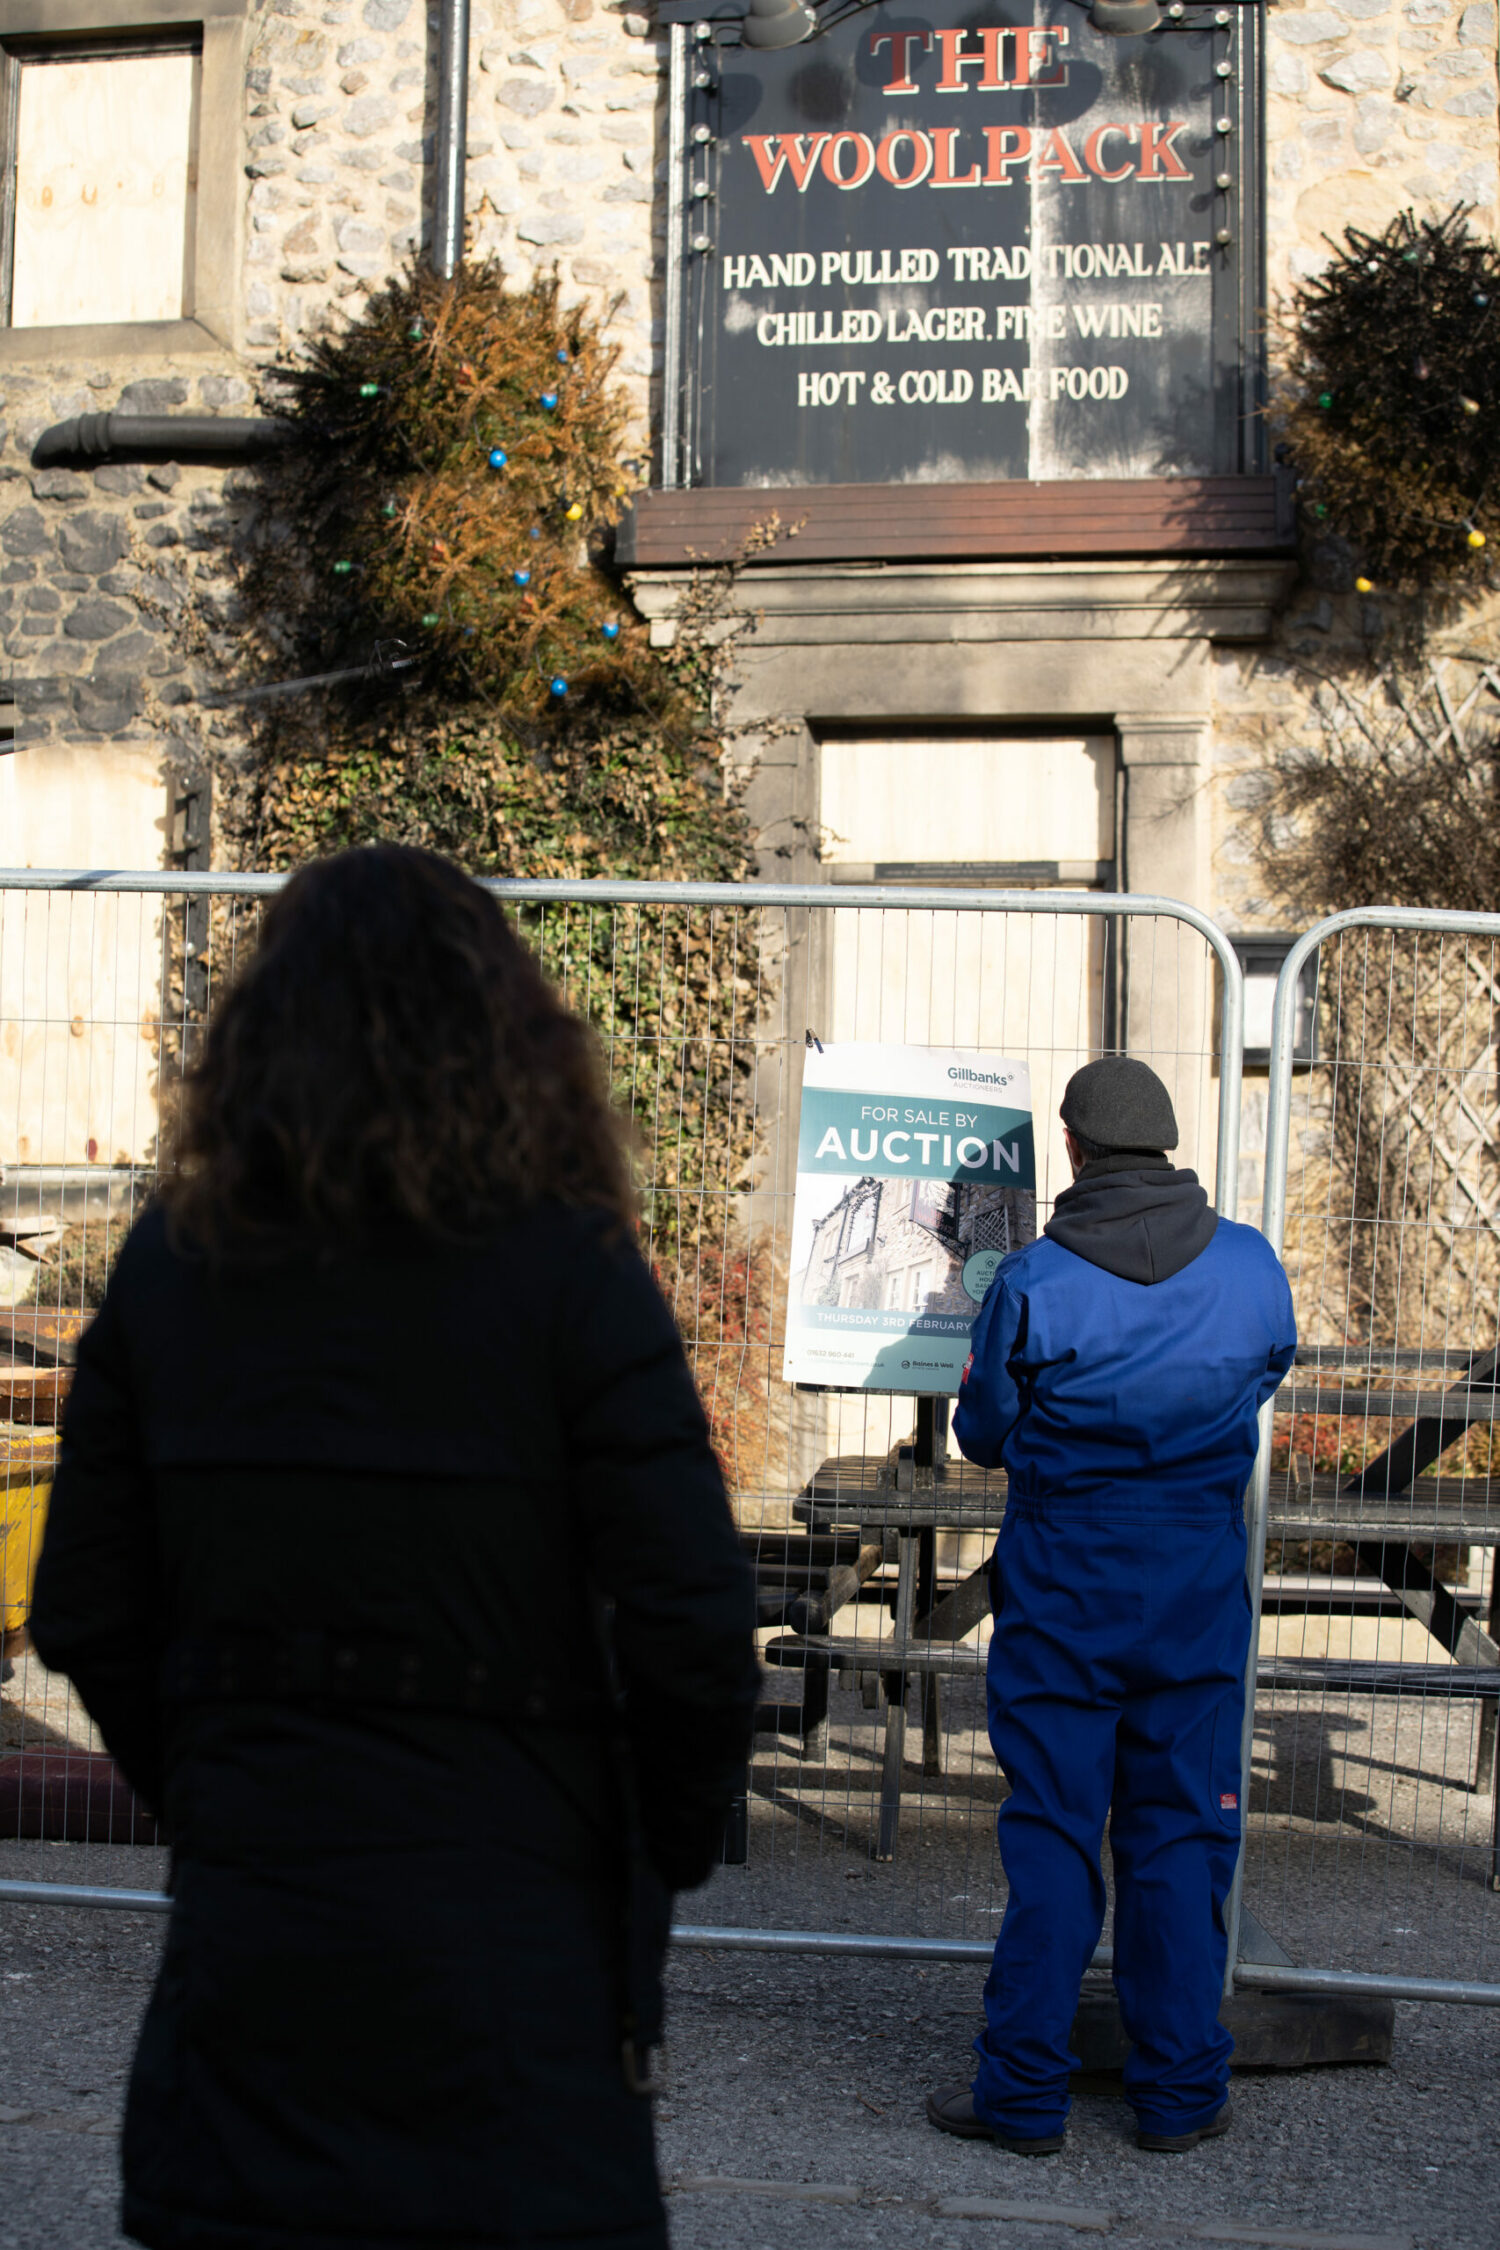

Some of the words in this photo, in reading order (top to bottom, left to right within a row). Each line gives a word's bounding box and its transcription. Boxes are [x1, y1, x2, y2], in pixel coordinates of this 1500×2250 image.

[869, 25, 1070, 95] THE
[742, 120, 1194, 194] WOOLPACK
[723, 252, 816, 289] HAND
[821, 248, 939, 286] PULLED
[947, 242, 1153, 282] TRADTIONAL
[1155, 241, 1211, 277] ALE
[757, 309, 882, 347] CHILLED
[1072, 303, 1163, 339] WINE
[797, 371, 866, 407] HOT
[870, 373, 896, 405] &
[898, 369, 974, 404] COLD
[981, 367, 1045, 403] BAR
[1049, 365, 1129, 401] FOOD
[947, 1066, 1008, 1086] Gillbanks
[953, 1081, 1003, 1093] AUCTIONEERS
[861, 1106, 899, 1123] FOR
[903, 1108, 950, 1127] SALE
[955, 1113, 978, 1129] BY
[814, 1126, 1020, 1173] AUCTION
[816, 1312, 879, 1326] THURSDAY
[882, 1317, 906, 1328] 3RD
[909, 1319, 972, 1331] FEBRUARY
